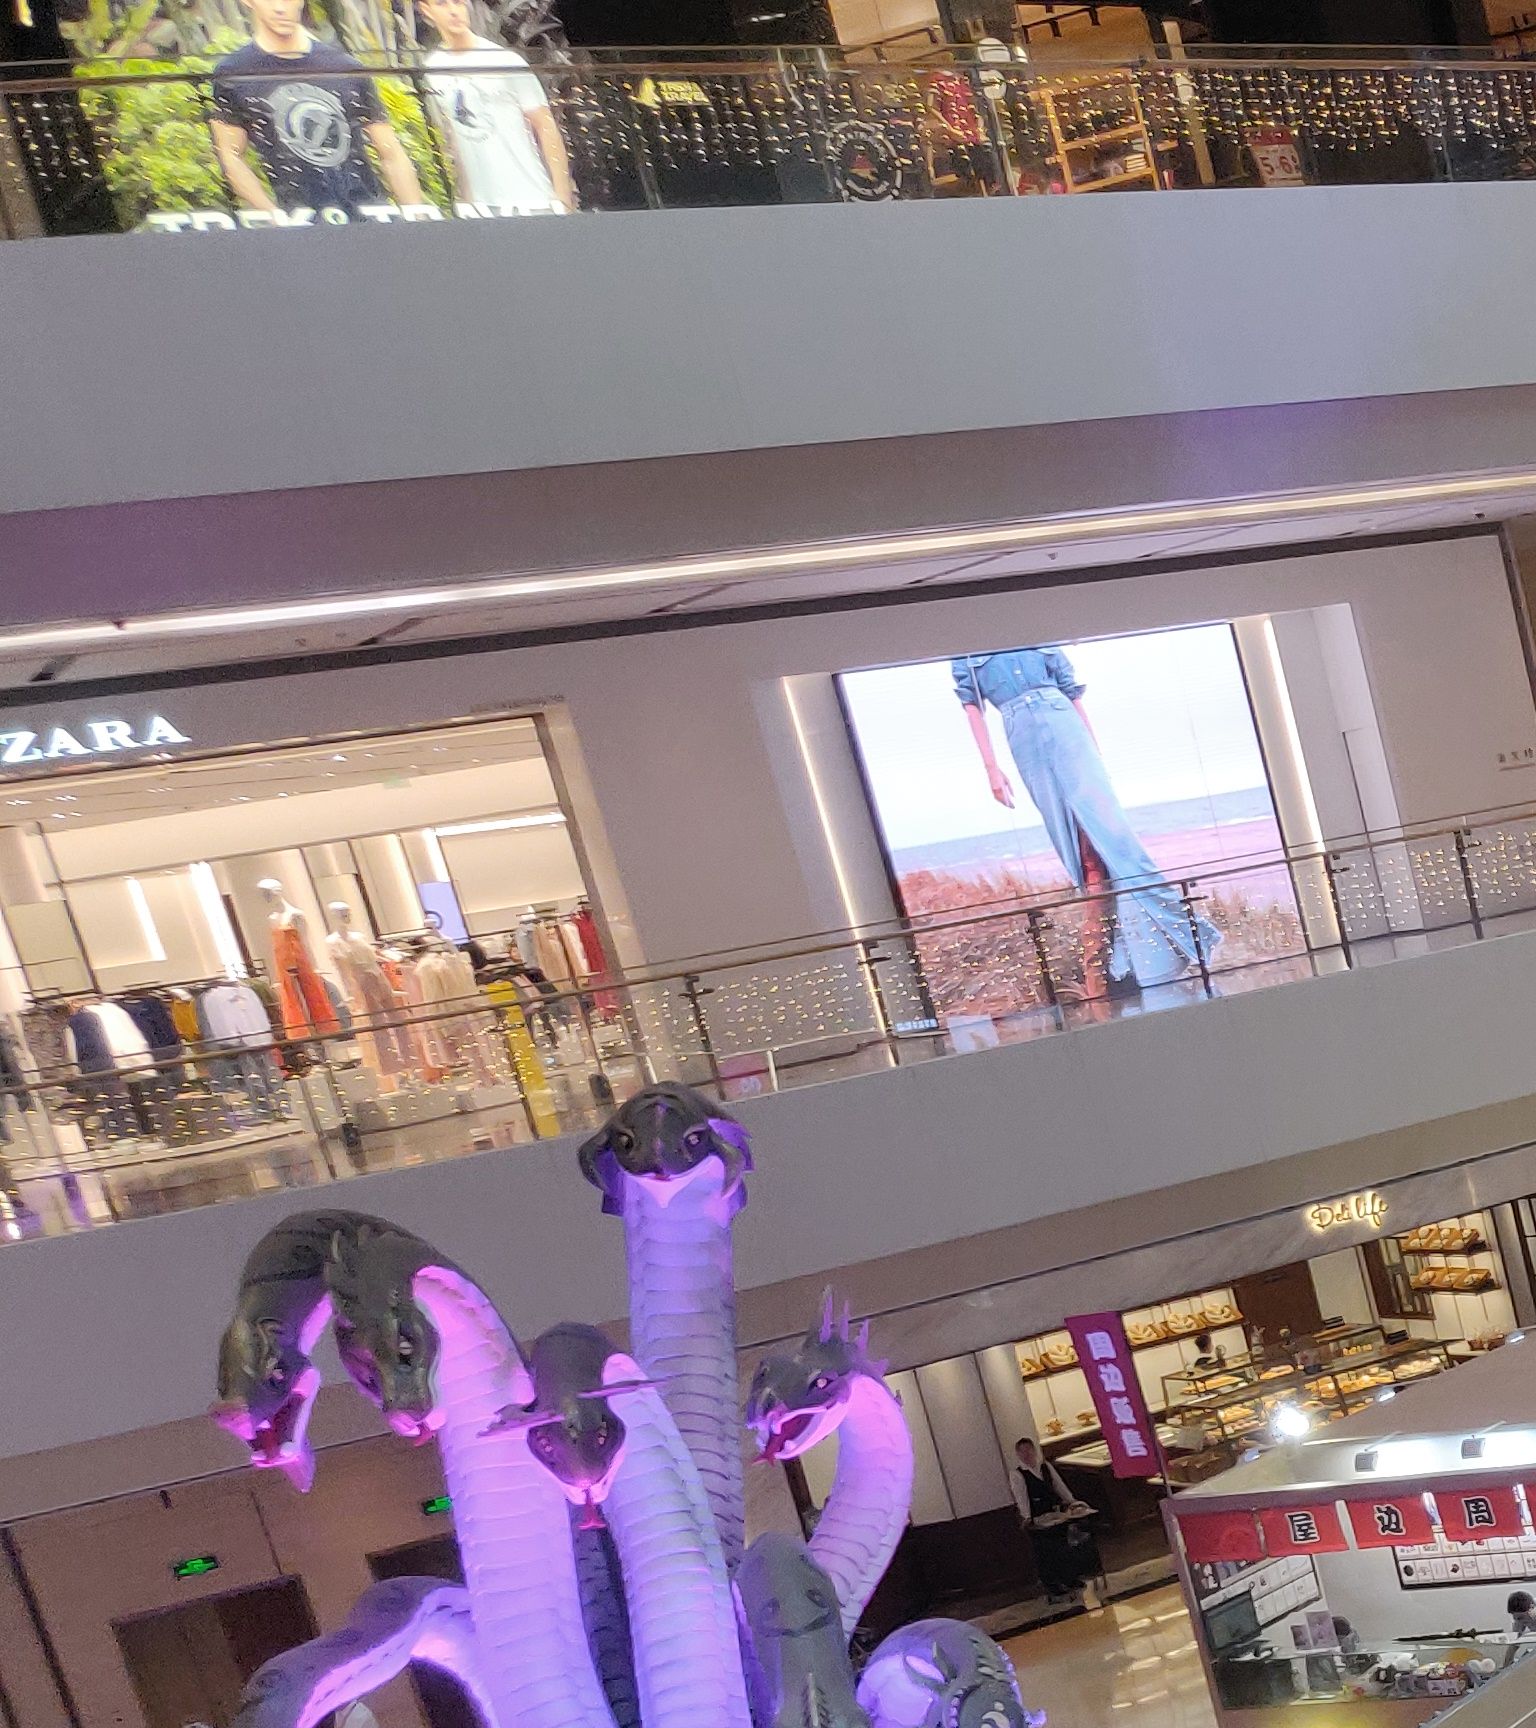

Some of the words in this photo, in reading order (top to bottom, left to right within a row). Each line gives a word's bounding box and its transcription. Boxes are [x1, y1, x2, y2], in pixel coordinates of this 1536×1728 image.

[0, 716, 192, 763] ZARA
[1311, 1202, 1352, 1229] Deli
[1355, 1192, 1390, 1227] life
